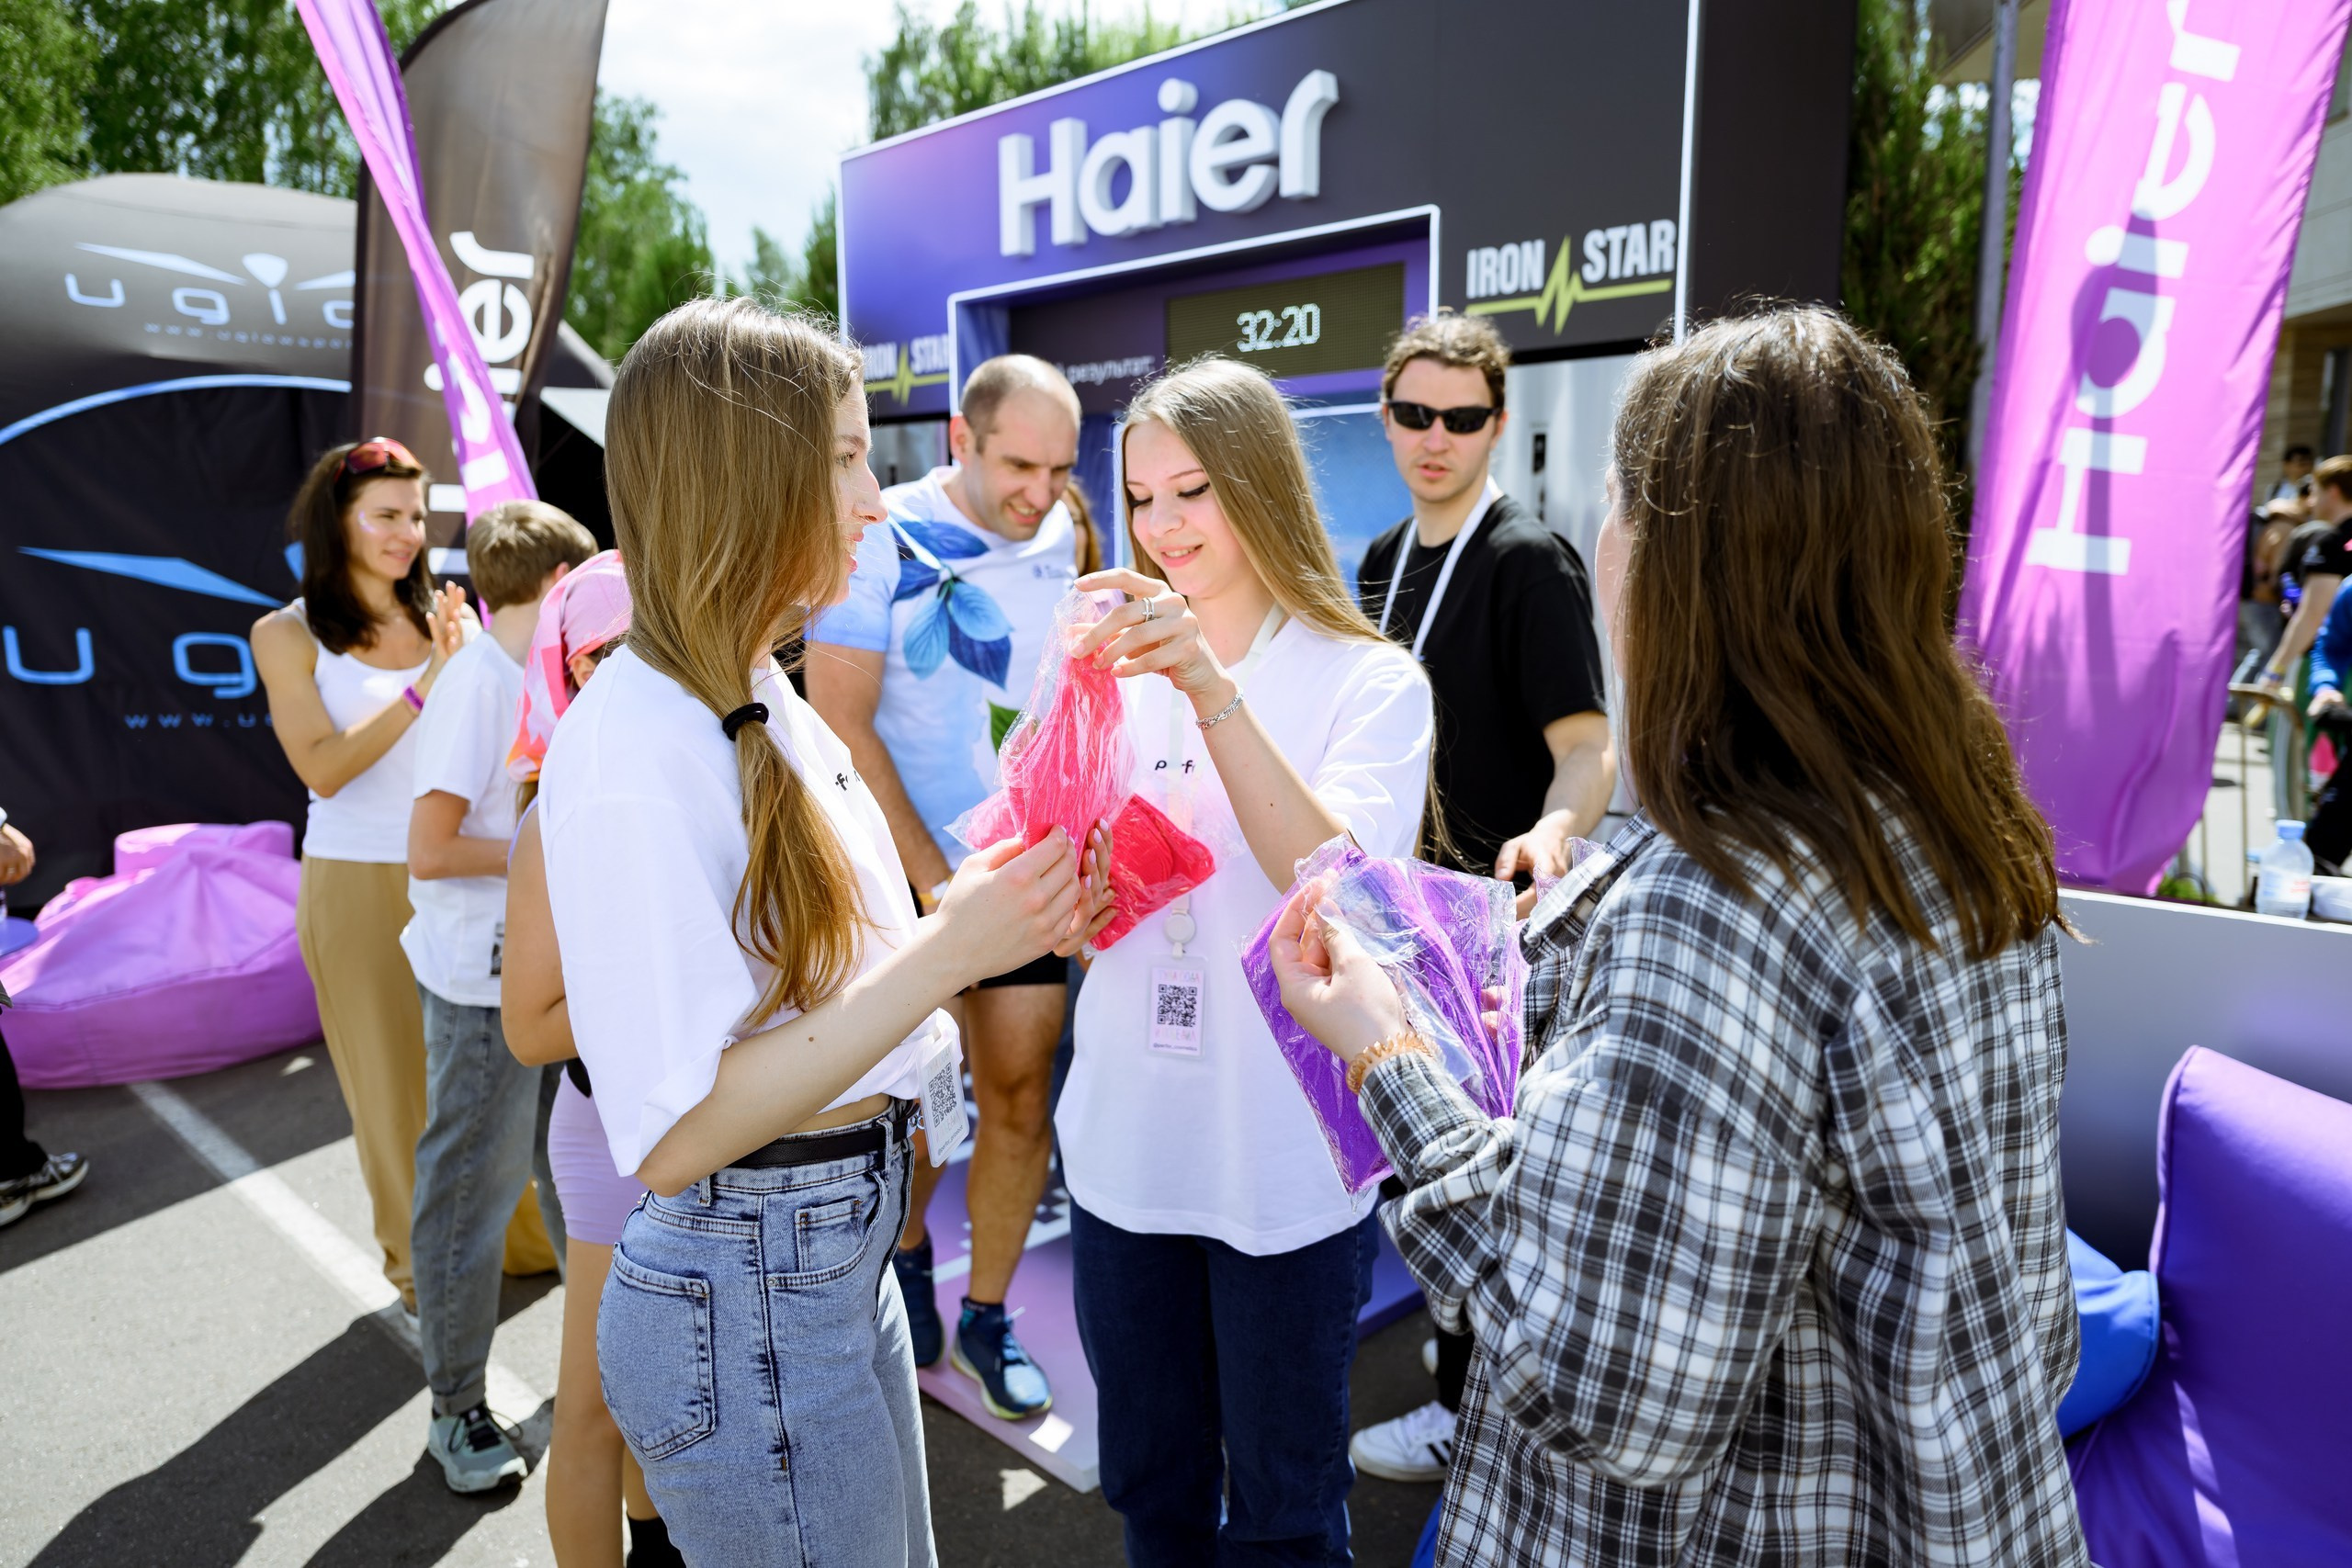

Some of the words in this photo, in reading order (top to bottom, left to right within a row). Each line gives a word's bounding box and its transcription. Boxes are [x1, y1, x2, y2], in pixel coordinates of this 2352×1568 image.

[999, 69, 1340, 256] Haier
[1466, 238, 1545, 299] IRON
[1582, 219, 1676, 283] STAR
[1237, 303, 1320, 353] 32:20
